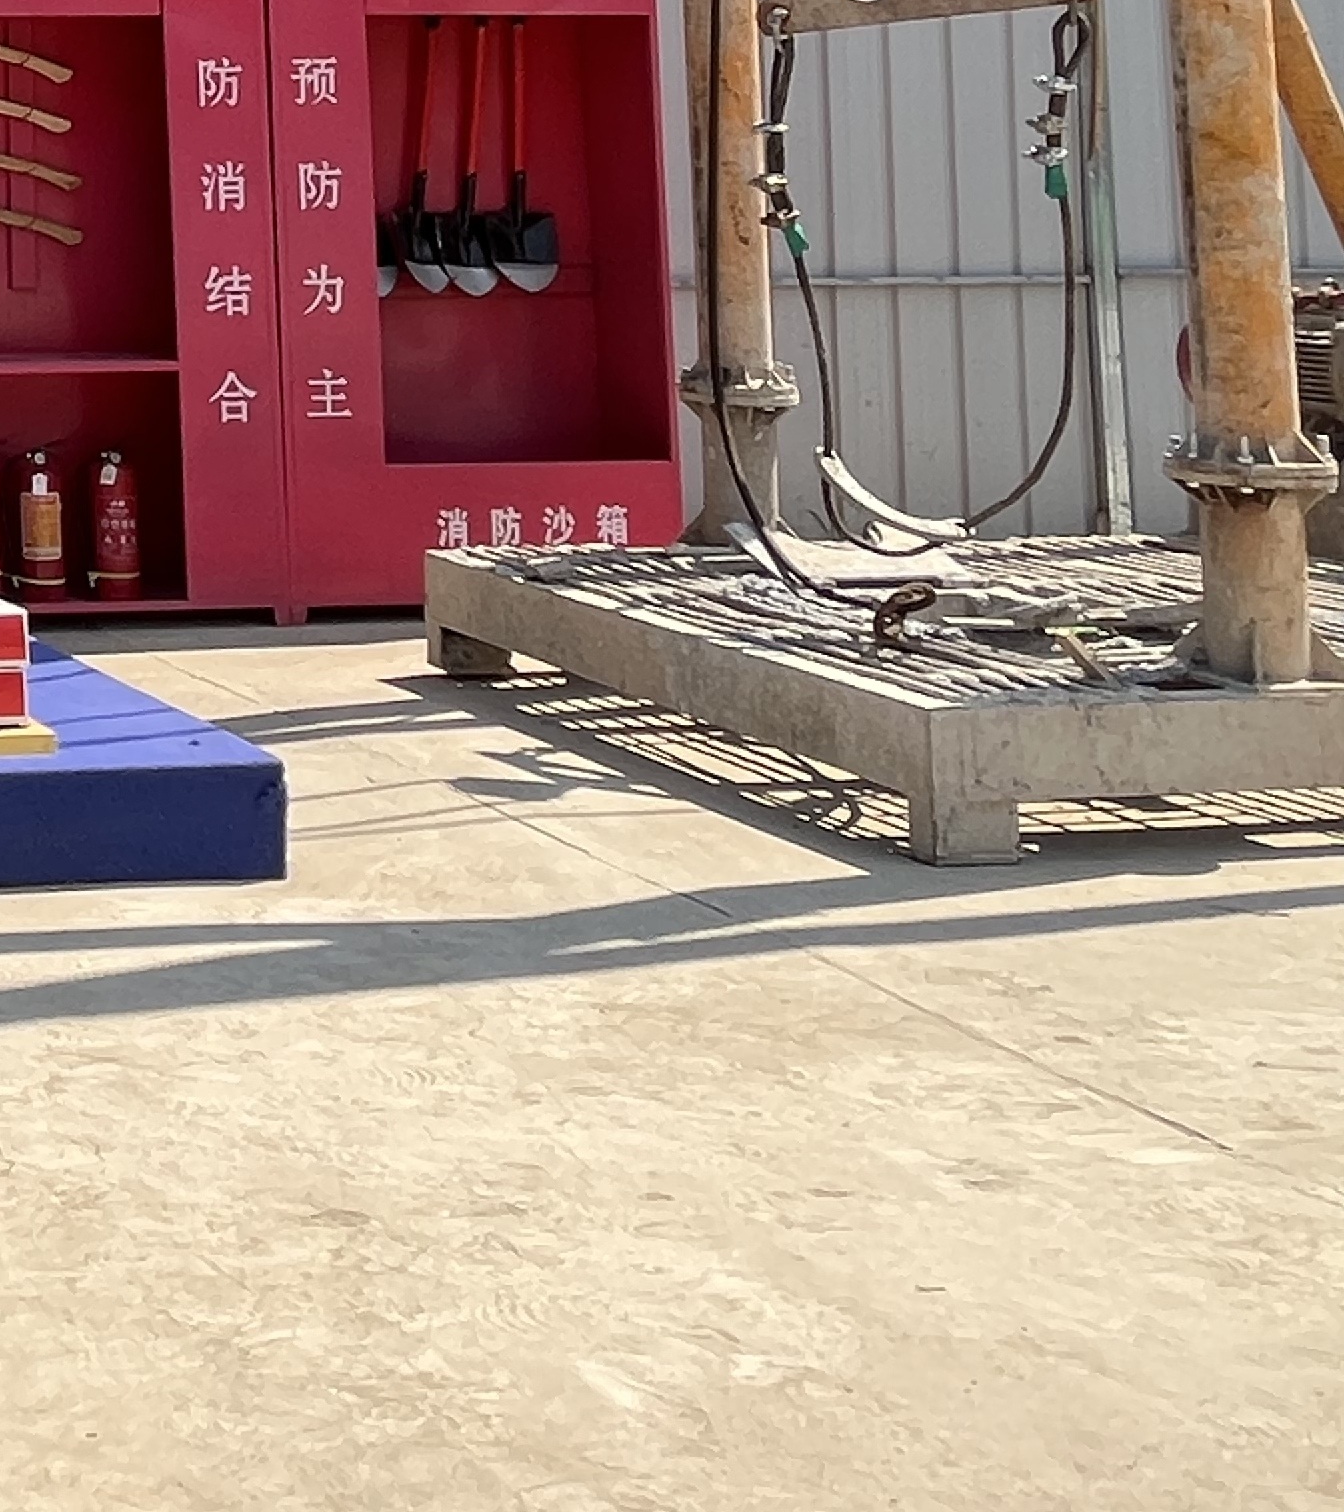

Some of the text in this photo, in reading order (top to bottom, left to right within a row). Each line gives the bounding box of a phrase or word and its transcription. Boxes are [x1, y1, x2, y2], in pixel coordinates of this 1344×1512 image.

[196, 56, 258, 425] 防消结合
[289, 55, 355, 421] 预防为主
[436, 504, 628, 547] 消防沙箱
